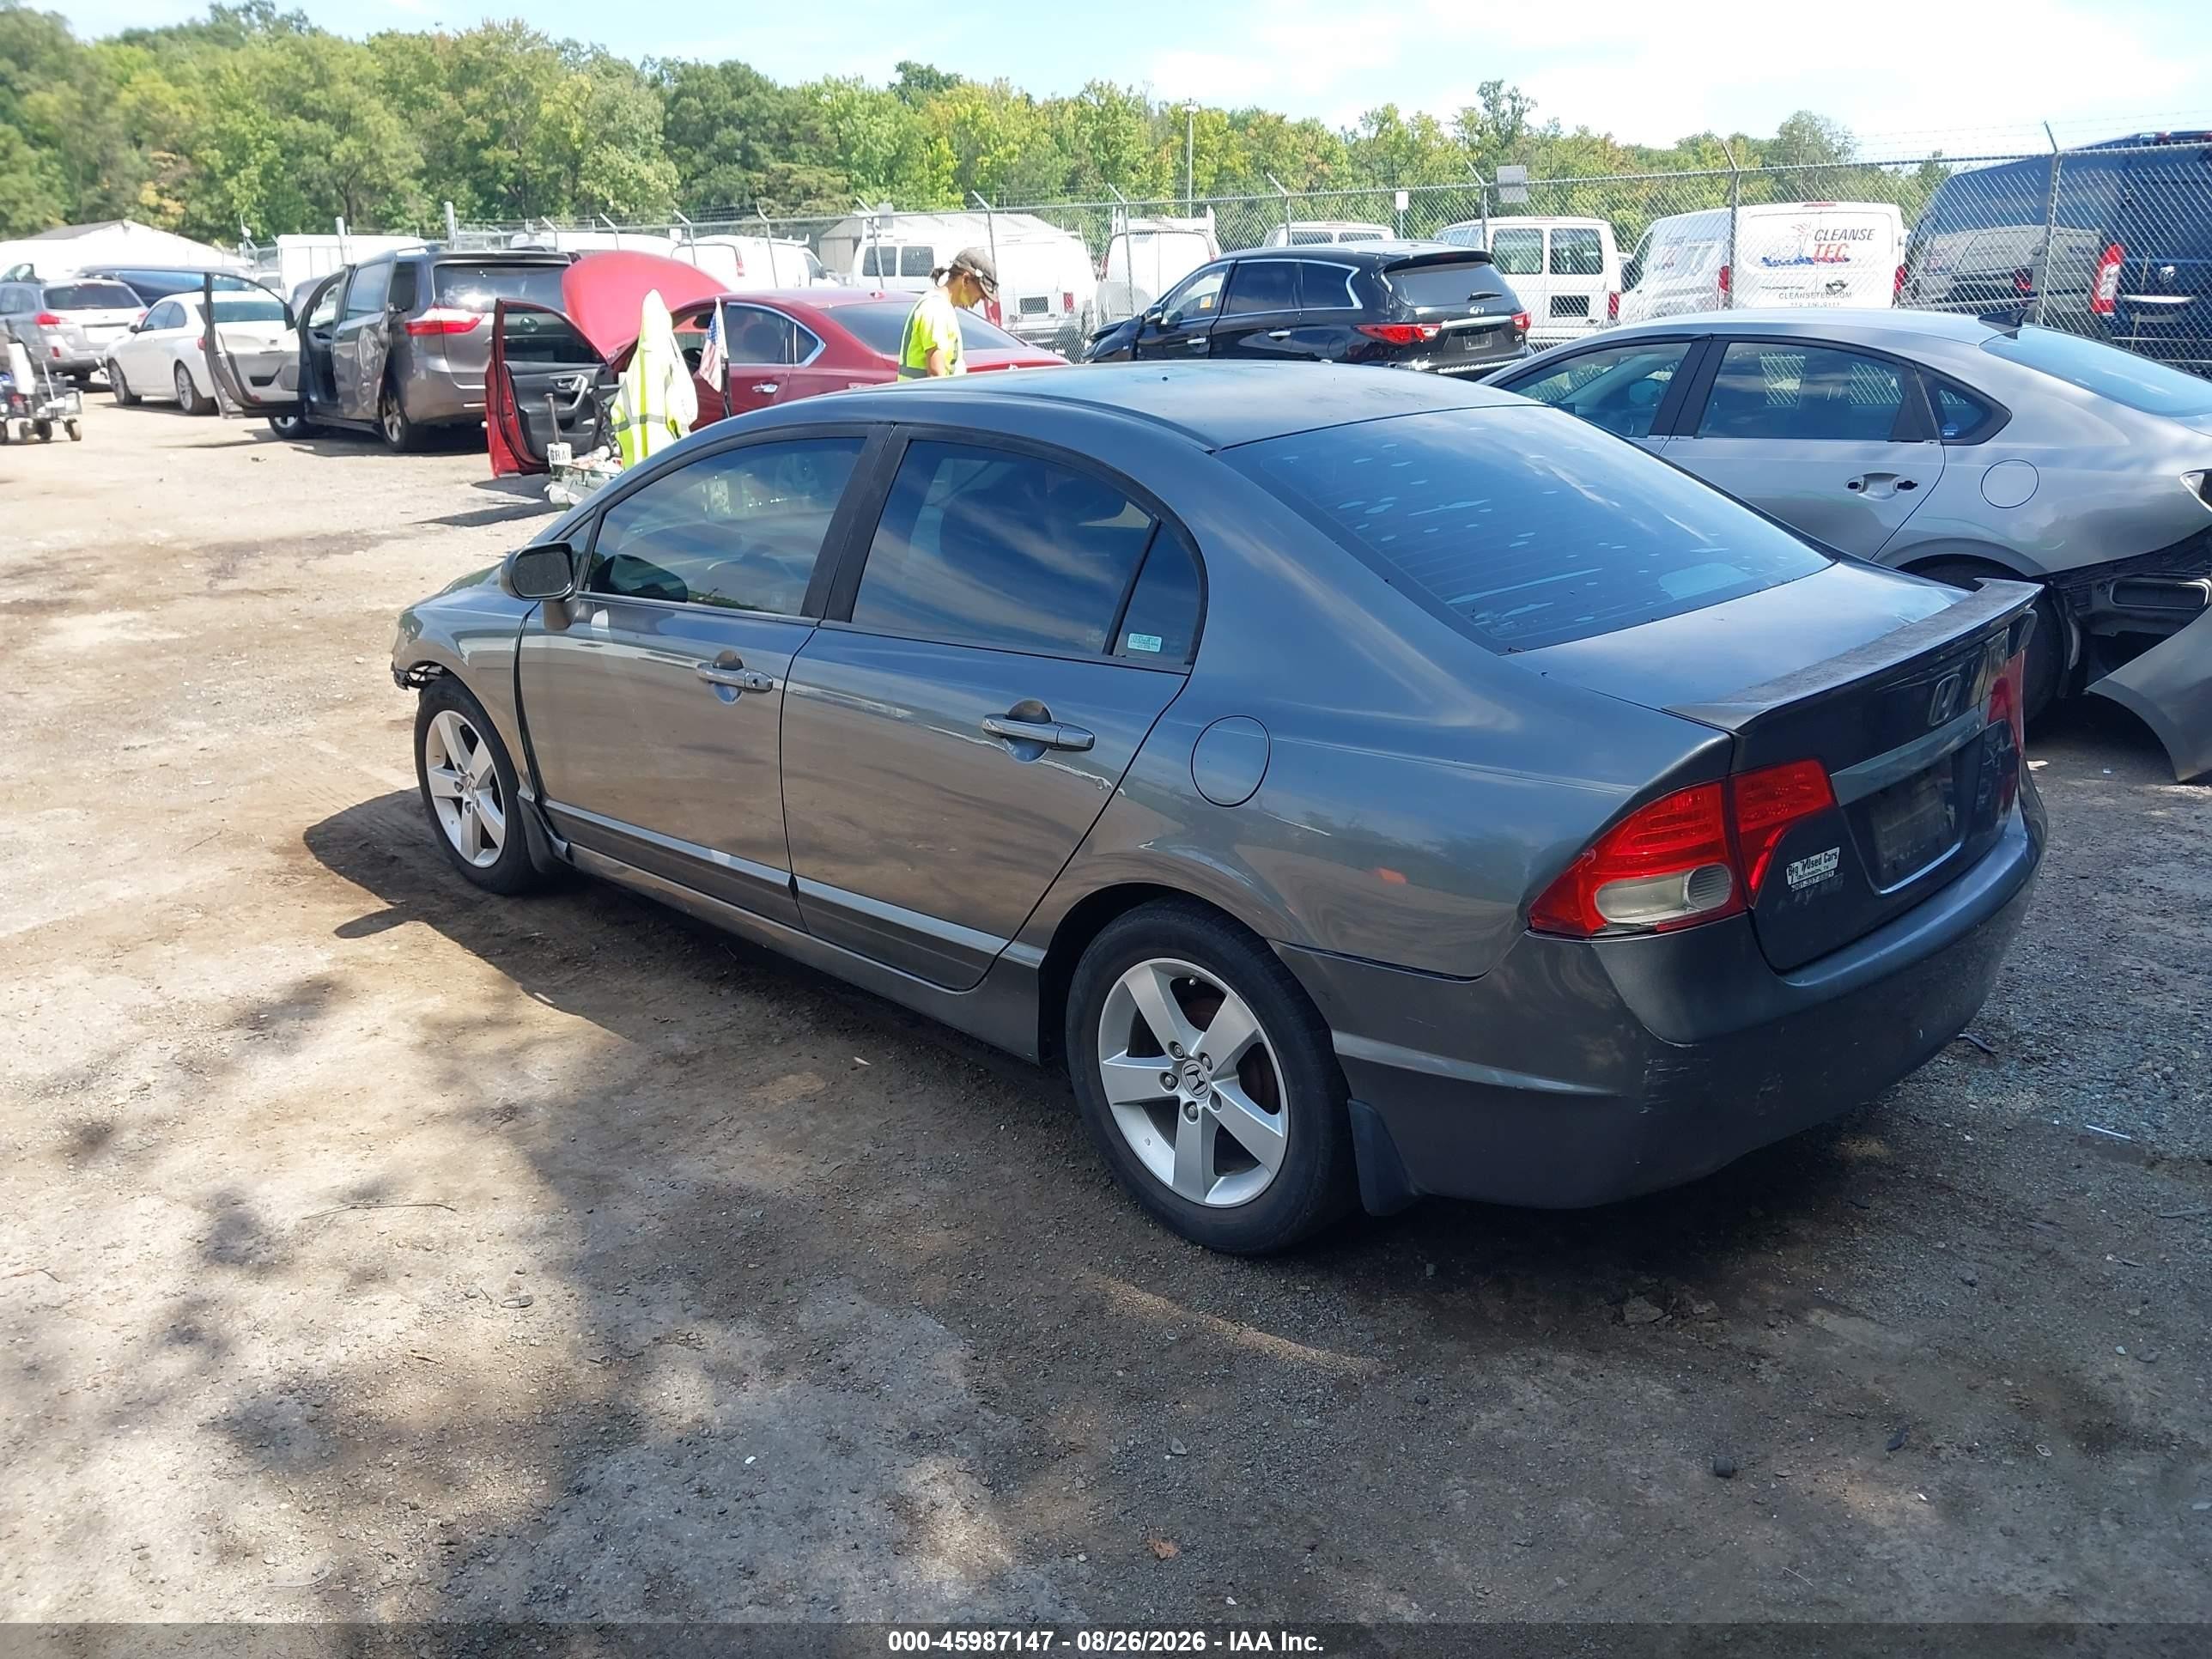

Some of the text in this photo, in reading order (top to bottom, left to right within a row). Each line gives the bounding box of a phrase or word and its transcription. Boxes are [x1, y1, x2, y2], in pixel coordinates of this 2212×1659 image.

[1814, 228, 1875, 241] CLEANSE
[1814, 243, 1850, 261] TEC
[1788, 864, 1799, 877] Big
[1824, 852, 1838, 863] Cars
